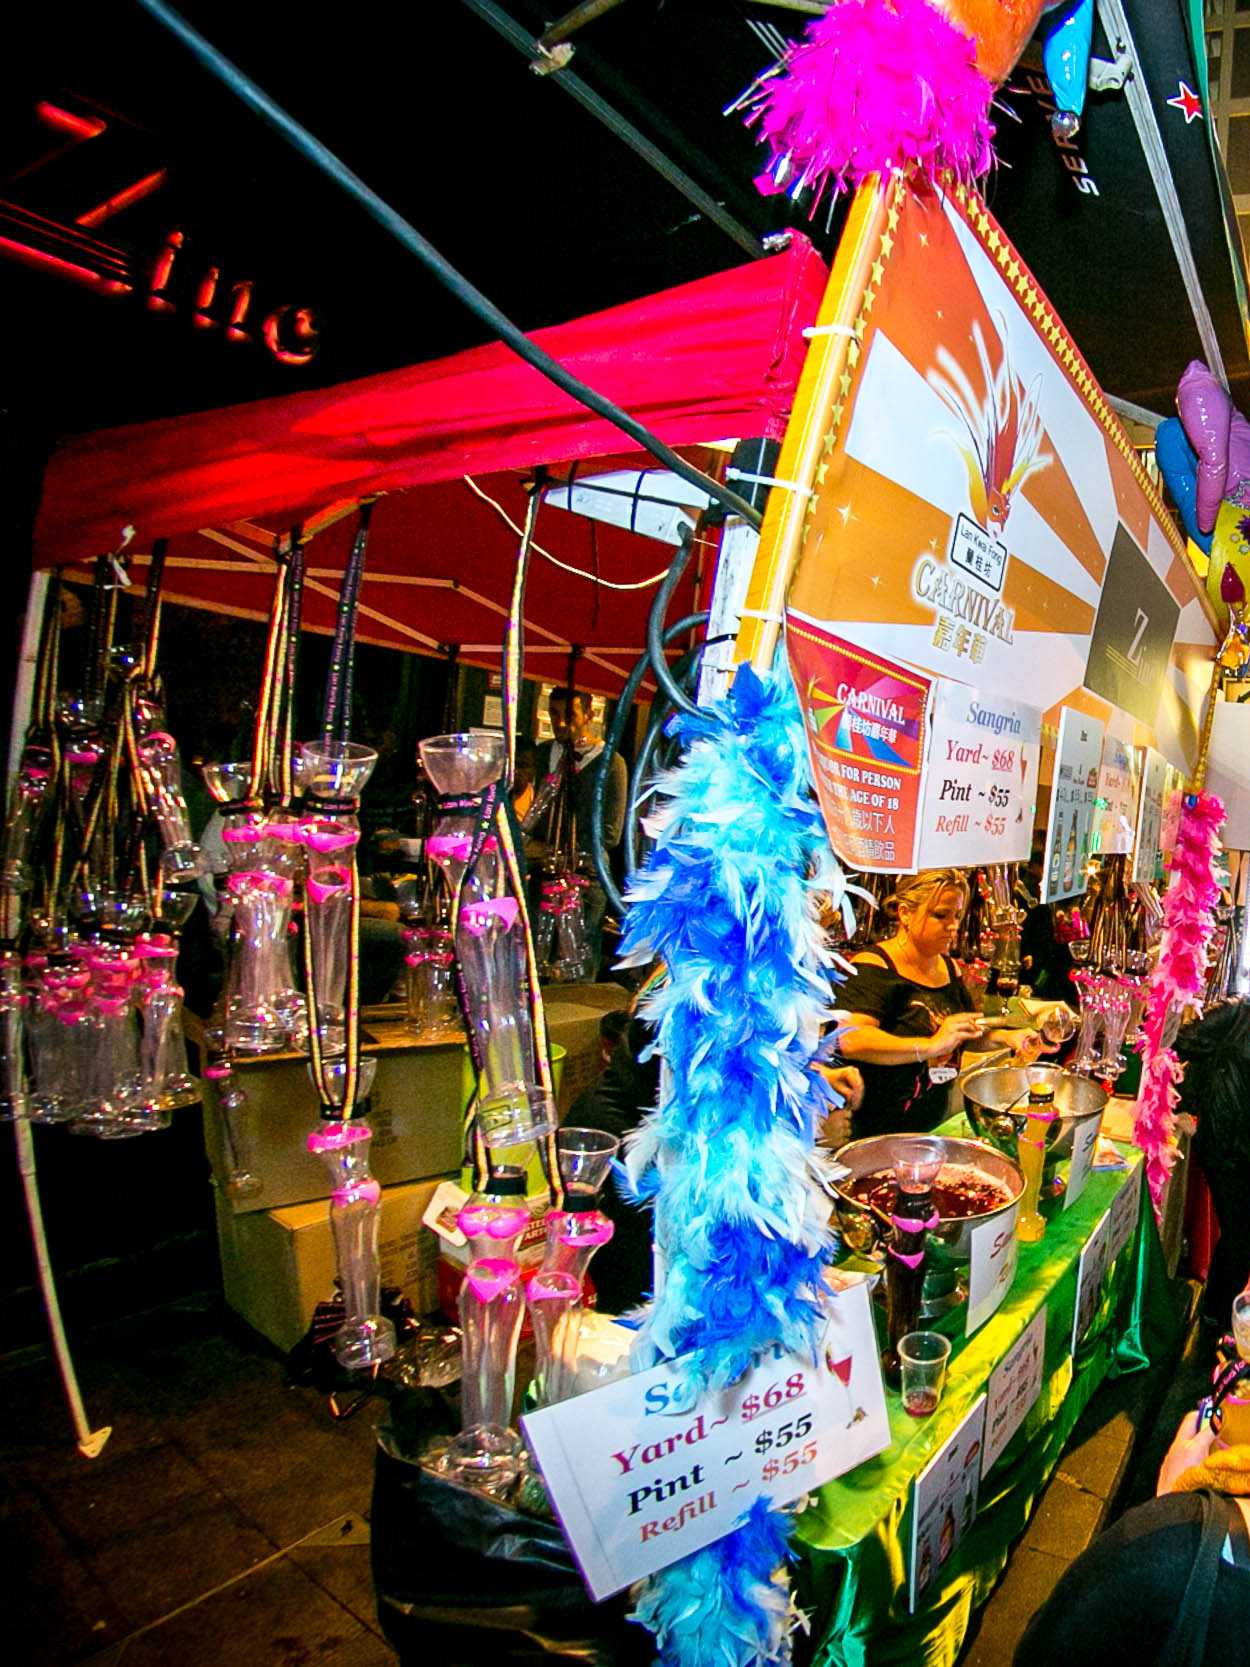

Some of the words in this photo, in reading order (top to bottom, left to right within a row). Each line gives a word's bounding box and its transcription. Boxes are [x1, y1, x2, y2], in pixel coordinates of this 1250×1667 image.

[914, 559, 1014, 646] CARNIVAL
[836, 682, 906, 726] CARNIVAL
[966, 701, 1021, 735] Sangria
[991, 747, 1015, 771] $68
[841, 763, 860, 783] FOR
[861, 770, 902, 791] PERSON
[939, 779, 972, 802] Pint
[988, 785, 1010, 808] $55
[850, 790, 871, 807] AGE
[871, 793, 886, 808] OF
[887, 796, 900, 811] 18
[935, 814, 970, 836] Refill
[984, 814, 1007, 837] $55
[741, 1371, 807, 1422] $68
[627, 1464, 706, 1517] Pint
[754, 1412, 814, 1456] $55
[638, 1490, 718, 1543] Refill
[761, 1440, 819, 1483] $55
